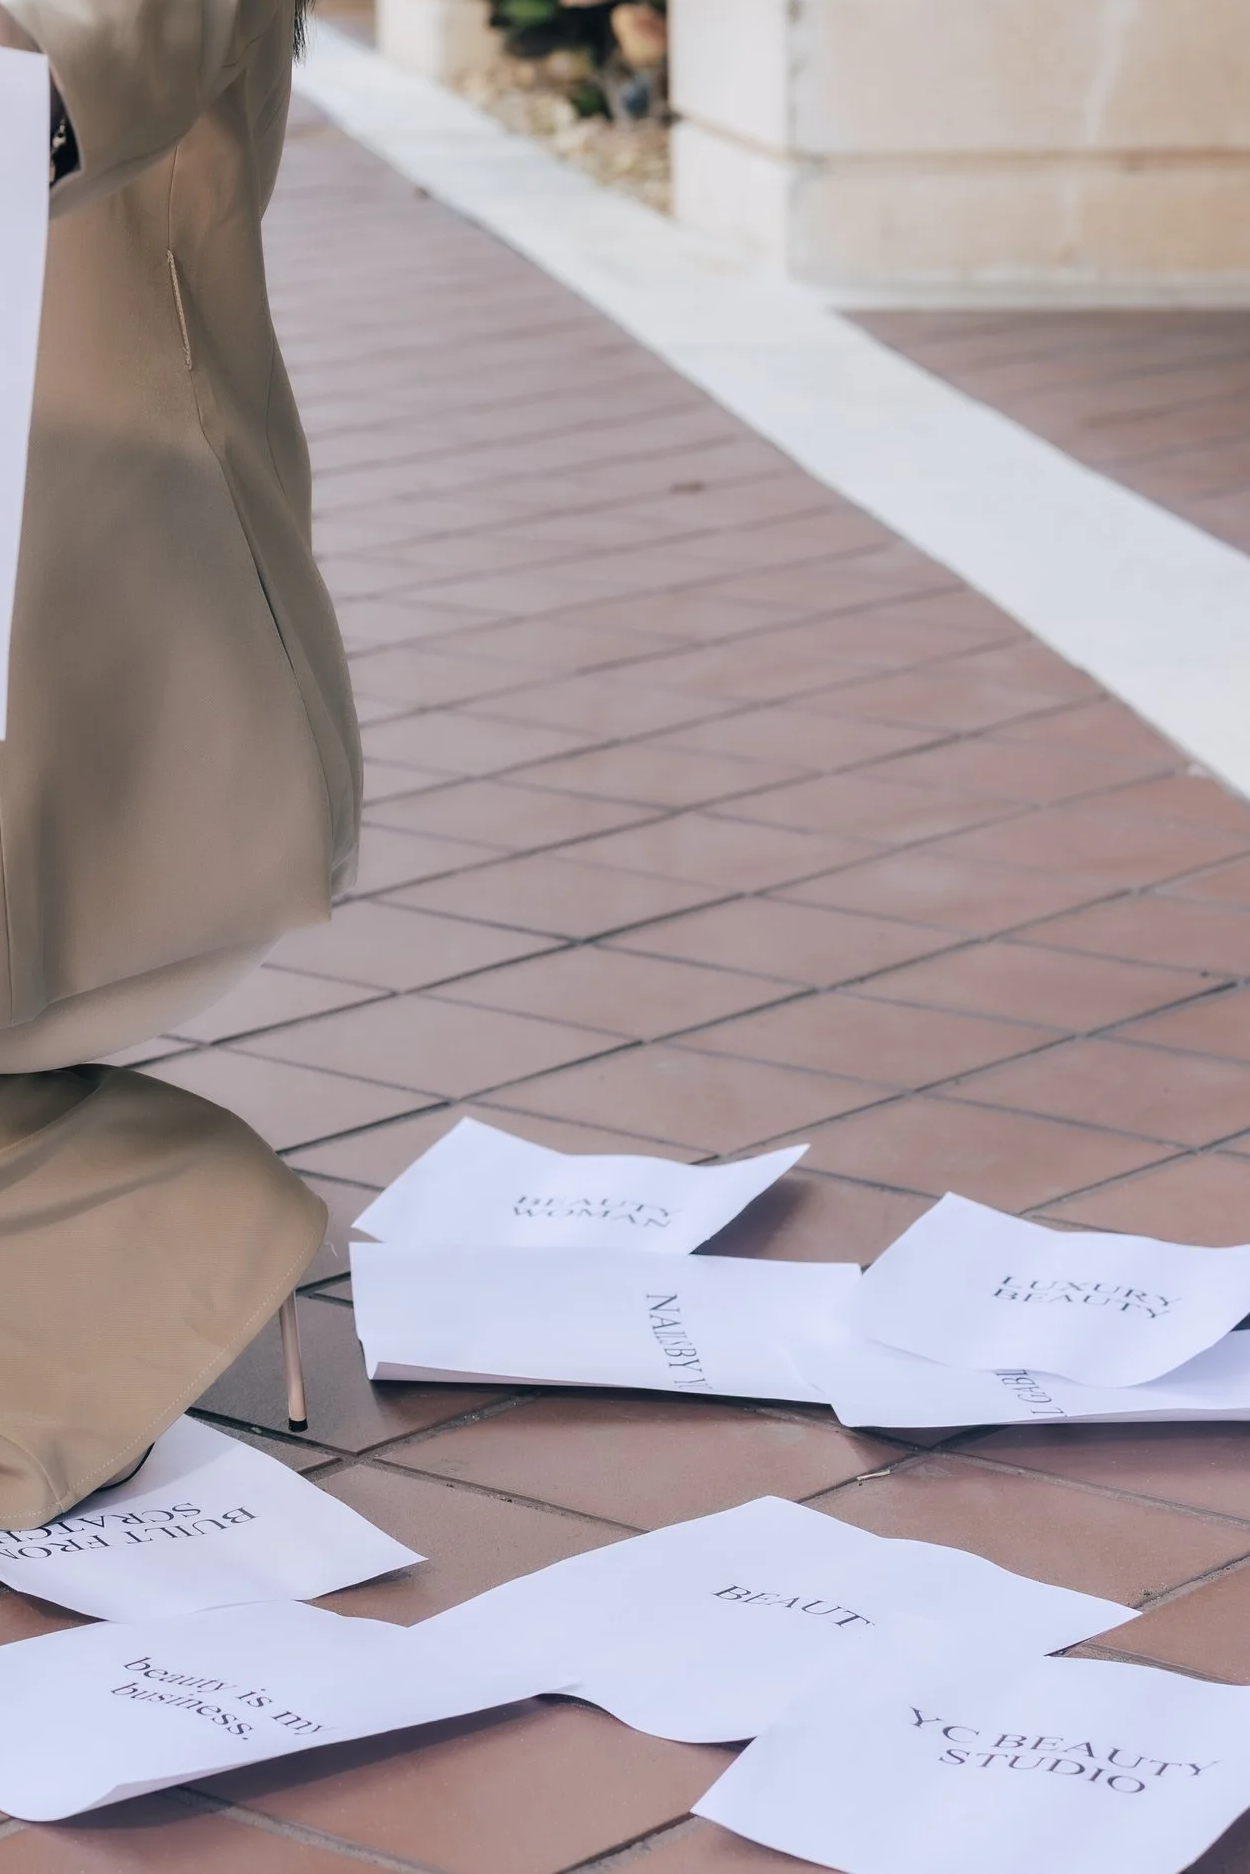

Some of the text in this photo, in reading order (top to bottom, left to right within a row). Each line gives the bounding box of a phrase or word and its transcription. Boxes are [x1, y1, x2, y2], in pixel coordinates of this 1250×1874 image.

[993, 1288, 1171, 1319] BEAUTY
[1002, 1276, 1182, 1307] LUXURY
[122, 1506, 260, 1544] BUILT
[709, 1584, 876, 1628] BEAUT
[110, 1682, 254, 1741] business.
[123, 1656, 338, 1736] beauty is my
[939, 1748, 1146, 1795] STUDIO
[991, 1734, 1223, 1777] BEAUTY
